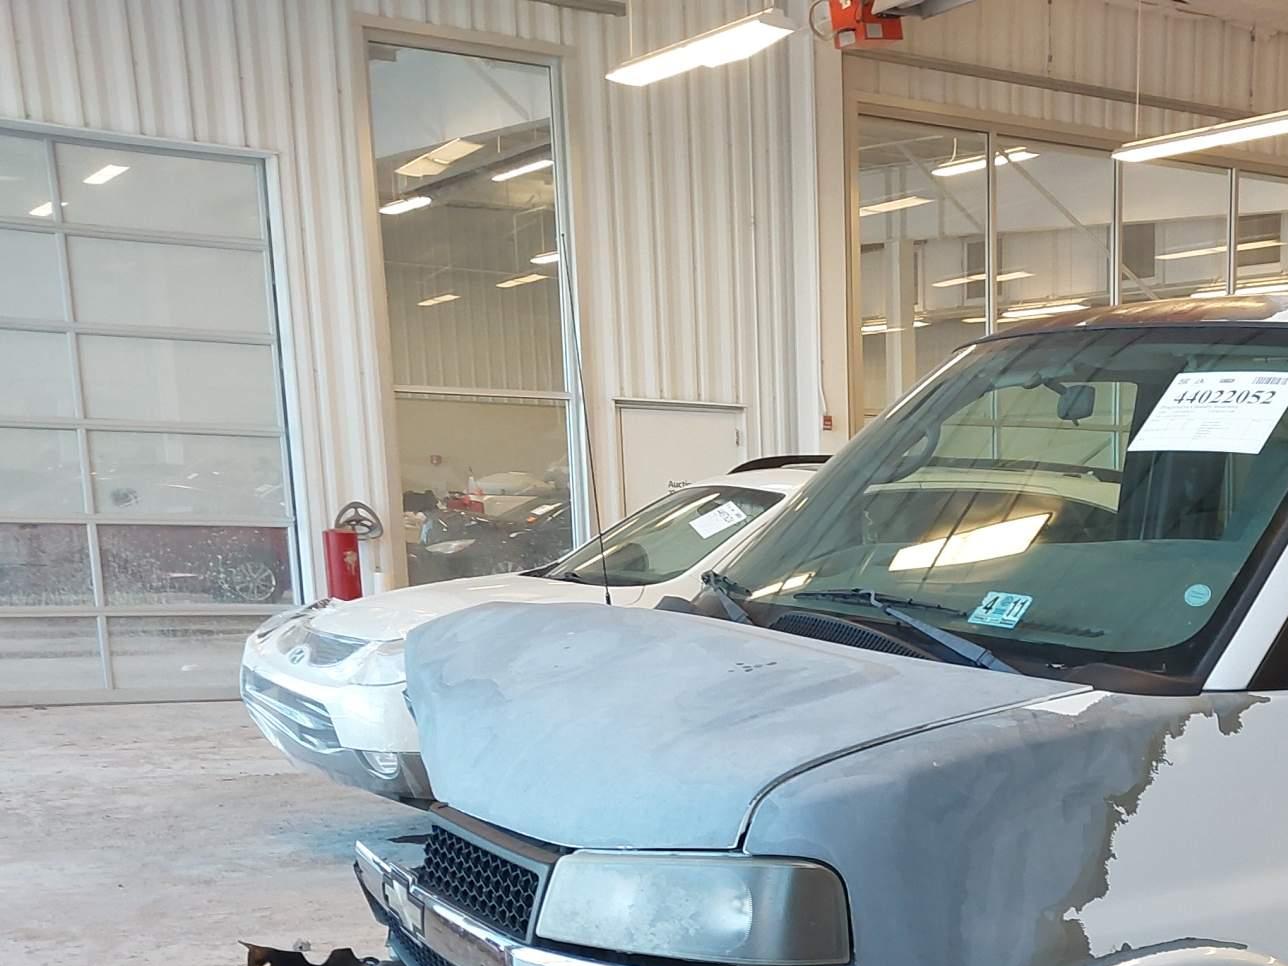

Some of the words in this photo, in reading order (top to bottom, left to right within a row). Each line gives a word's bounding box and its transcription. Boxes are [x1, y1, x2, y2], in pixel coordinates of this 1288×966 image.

[1174, 389, 1277, 404] 44022052
[668, 480, 692, 488] Aucti
[983, 596, 999, 614] 4
[1006, 598, 1028, 617] 11
